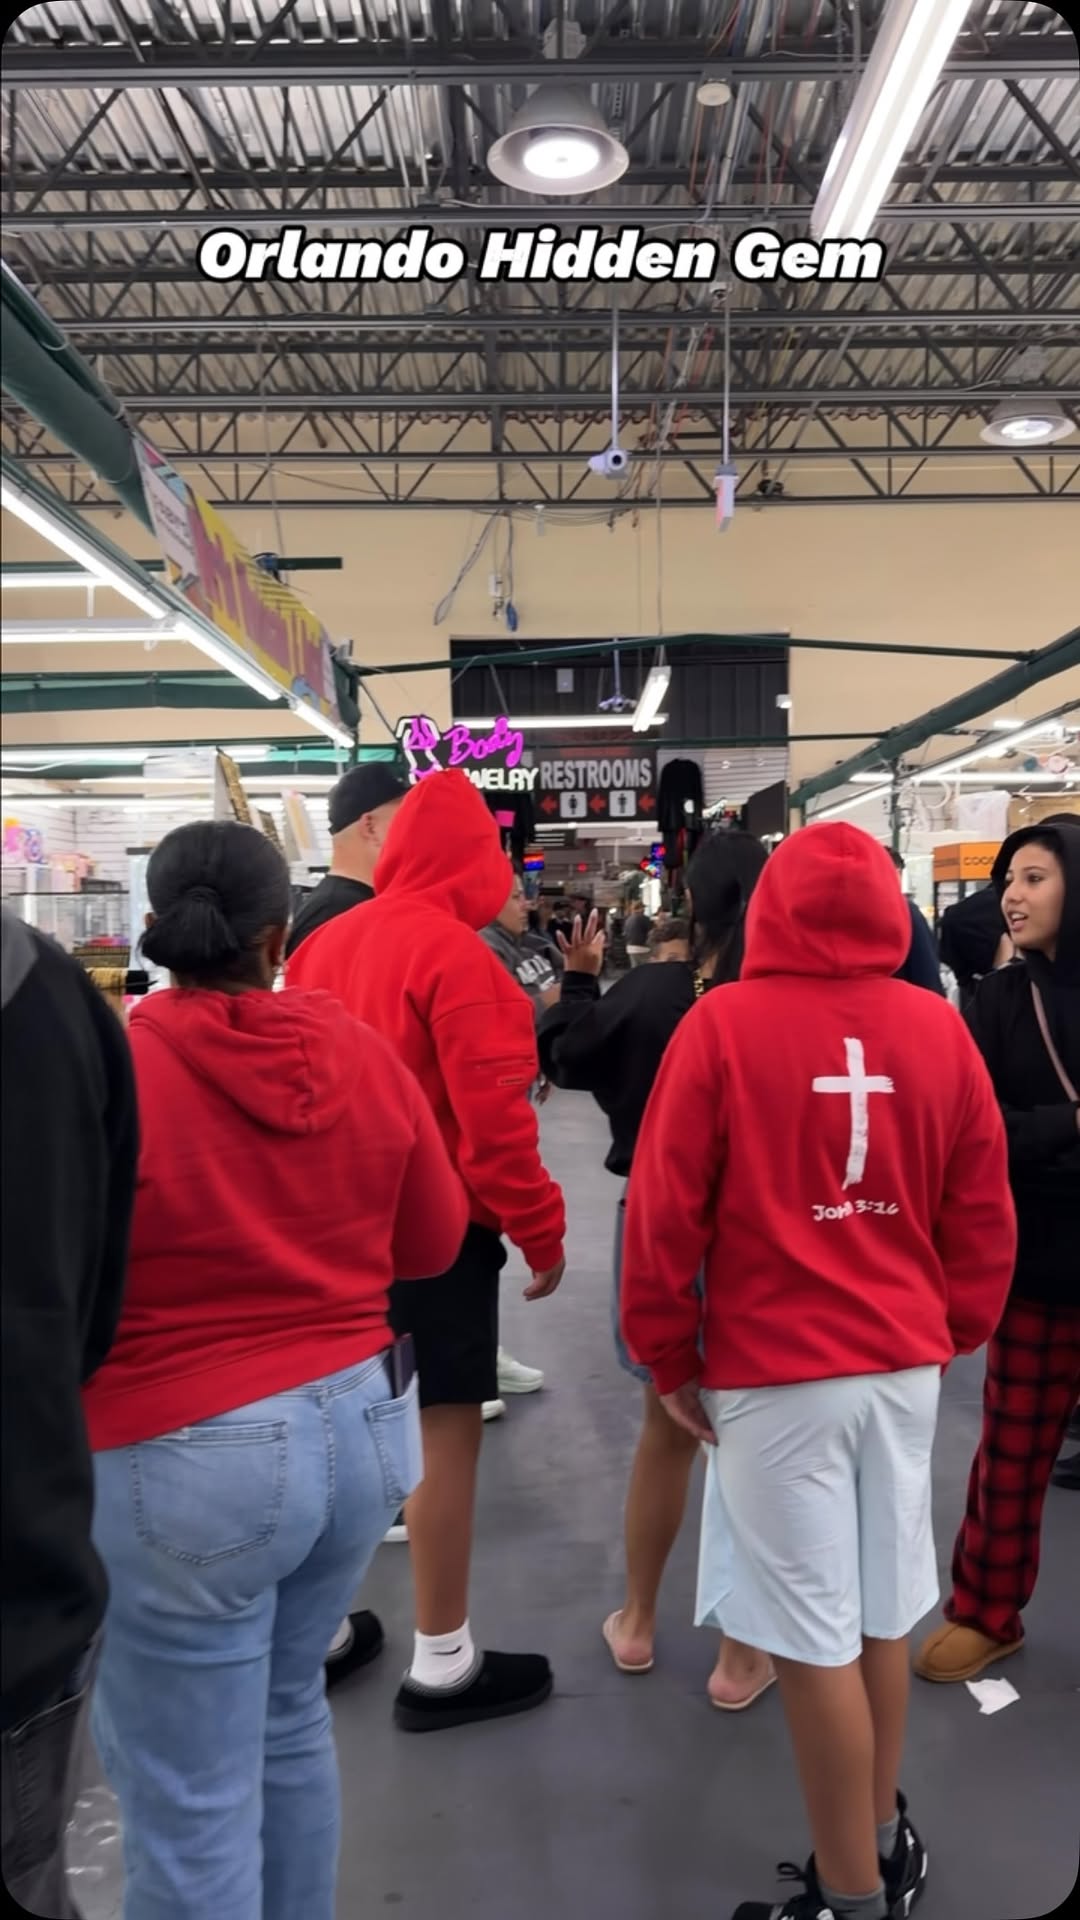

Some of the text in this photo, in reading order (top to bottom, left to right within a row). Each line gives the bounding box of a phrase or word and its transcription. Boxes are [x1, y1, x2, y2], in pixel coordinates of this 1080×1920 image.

[443, 716, 524, 768] Body
[463, 767, 540, 791] WELRY
[540, 758, 652, 790] RESTROOMS
[855, 1199, 899, 1215] 3:16
